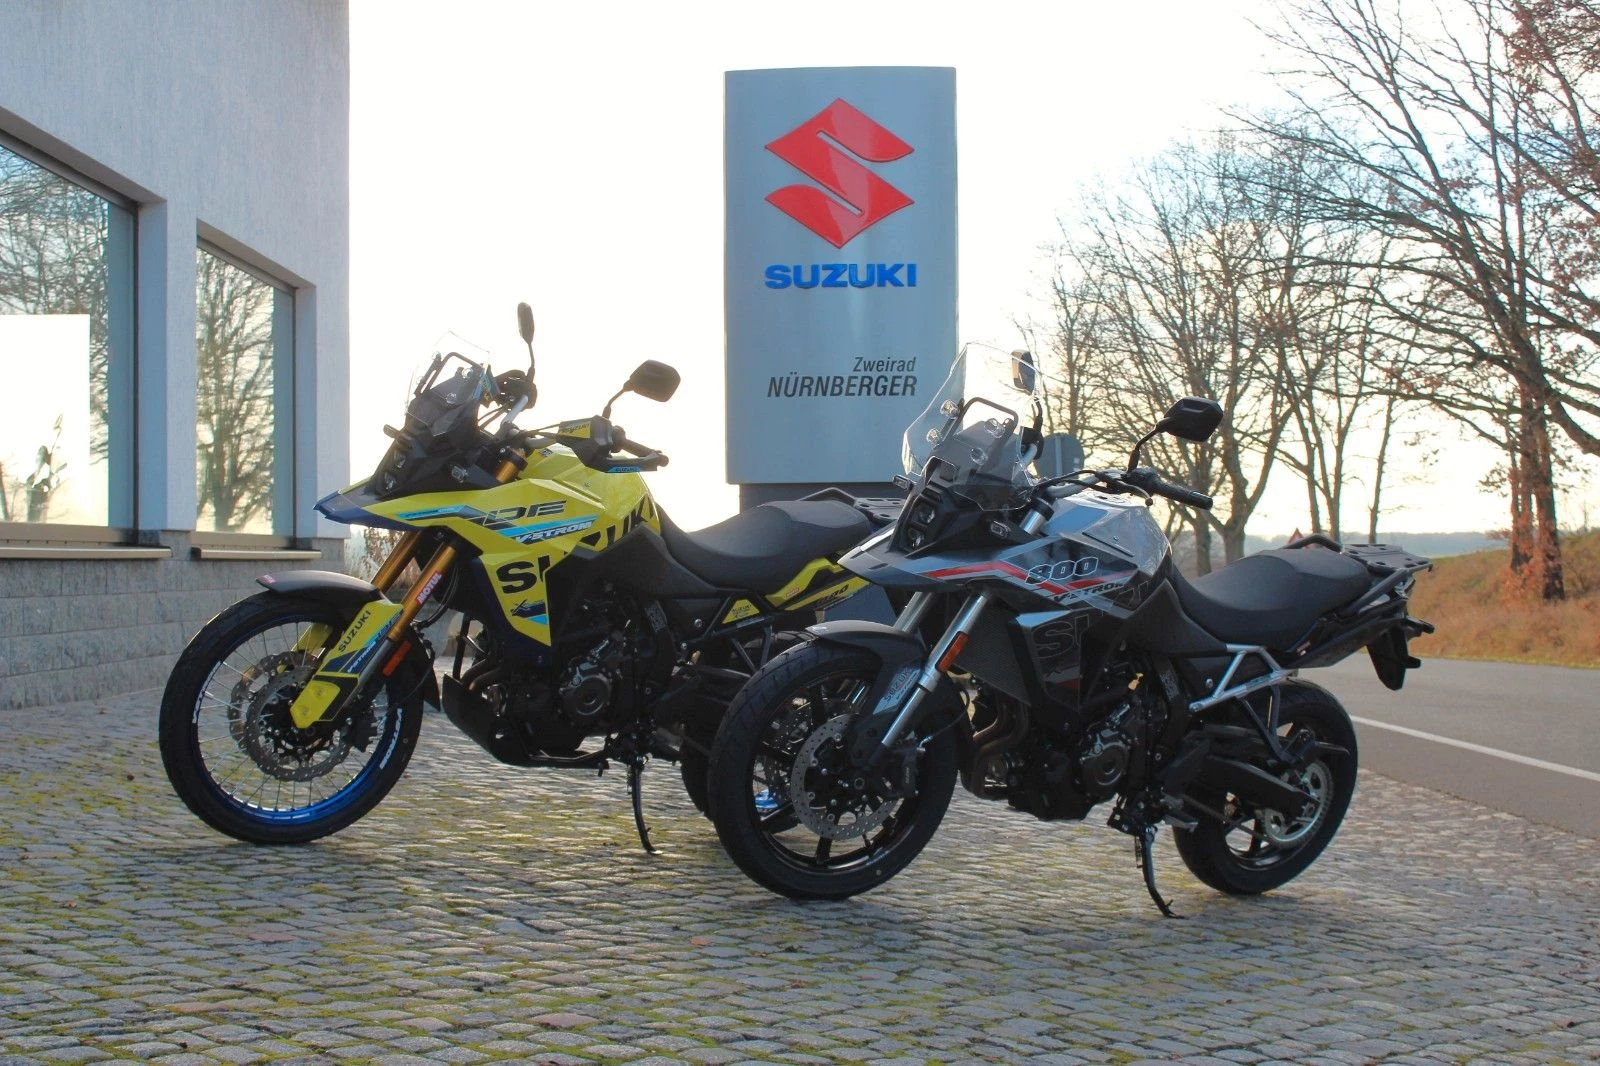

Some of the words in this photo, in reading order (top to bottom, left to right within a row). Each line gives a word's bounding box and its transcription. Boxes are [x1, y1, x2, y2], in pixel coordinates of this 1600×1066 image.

[764, 263, 918, 290] SUZUKI
[853, 356, 917, 373] Zweirad
[766, 371, 918, 398] NÜRNBERGER
[515, 520, 594, 543] V-STROM
[1025, 556, 1098, 585] 800
[416, 572, 443, 605] MOTUL
[338, 610, 371, 652] SUZUKI
